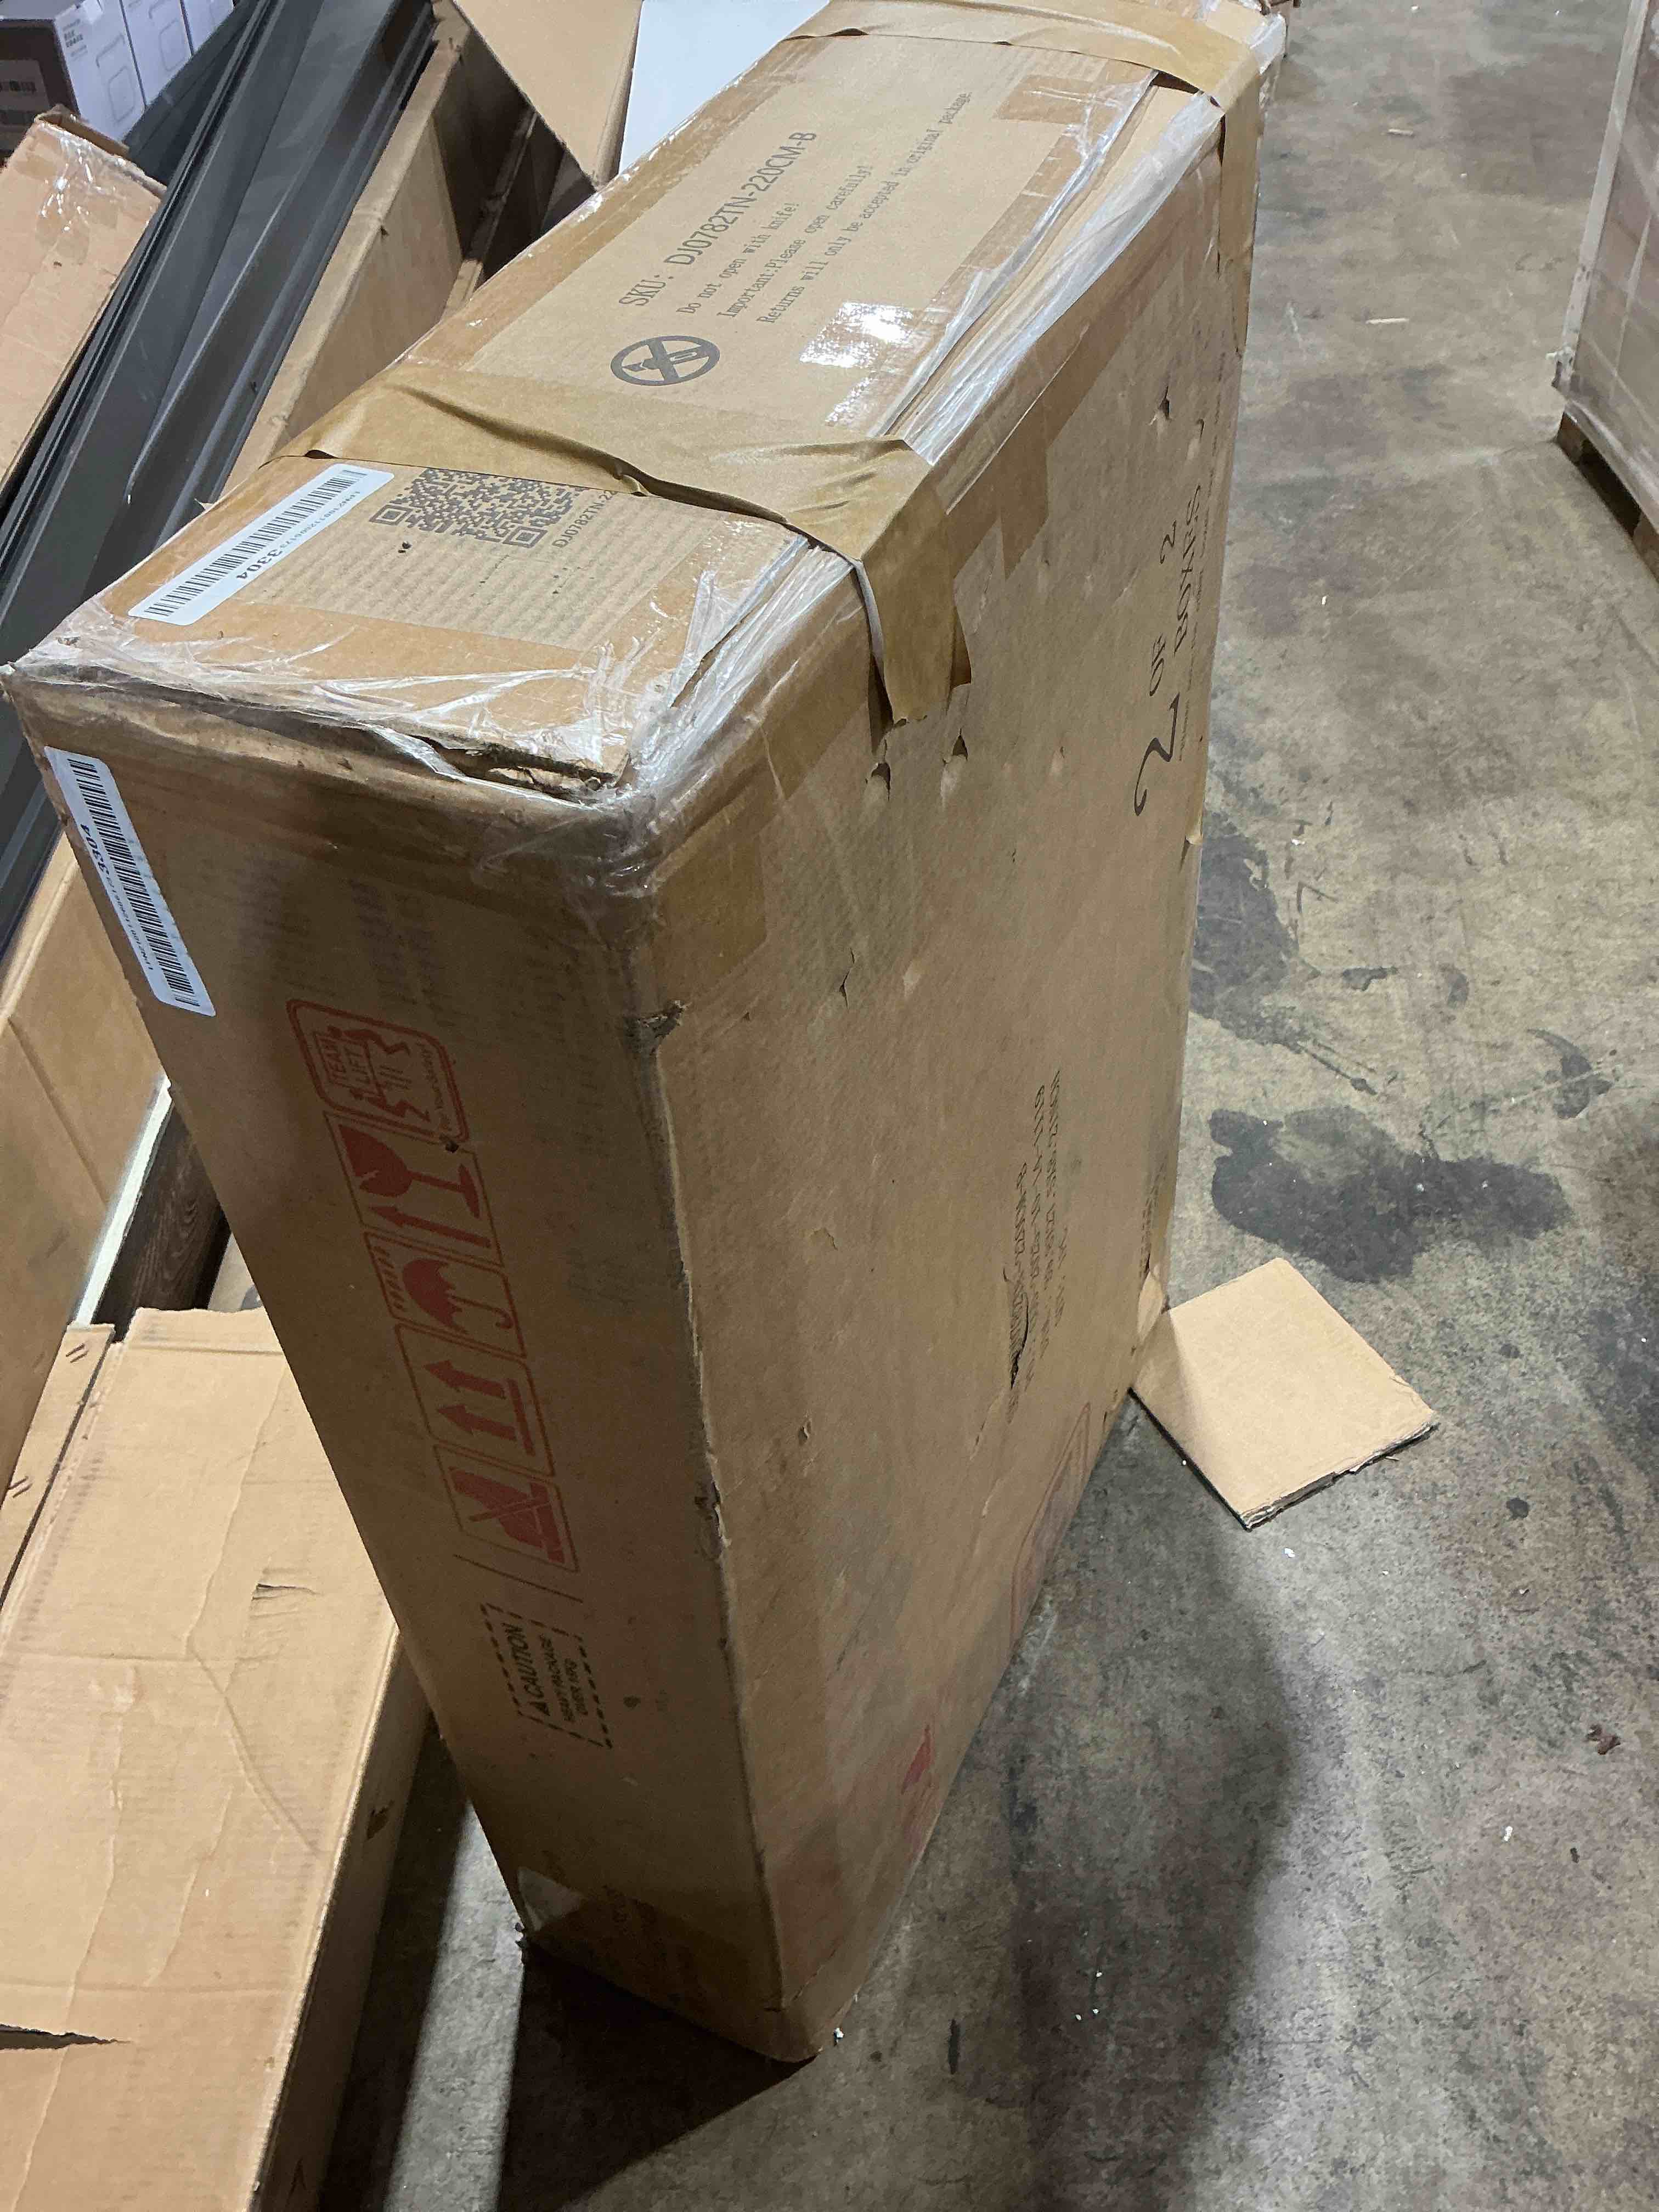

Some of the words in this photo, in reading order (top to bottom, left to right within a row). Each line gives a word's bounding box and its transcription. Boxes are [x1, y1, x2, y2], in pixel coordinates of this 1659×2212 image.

[618, 274, 674, 307] SKU:
[663, 132, 817, 266] DJ0782TN-220CM-B
[755, 284, 805, 323] Returns
[800, 260, 828, 281] will
[824, 236, 852, 256] only
[840, 221, 864, 232] be
[859, 180, 900, 219] accepted
[890, 166, 913, 177] in
[906, 127, 944, 163] original
[804, 214, 830, 234] open
[826, 165, 873, 211] carefully!
[676, 302, 702, 314] Do
[697, 281, 723, 298] not
[718, 257, 747, 279] open
[742, 233, 771, 253] with
[760, 202, 800, 230] knife!
[1159, 520, 1176, 565] 2
[1149, 633, 1166, 696] OF
[1135, 692, 1180, 816] 2
[320, 1038, 348, 1084] TEAM
[343, 1046, 371, 1085] LIFT
[501, 1622, 544, 1699] CAUTION
